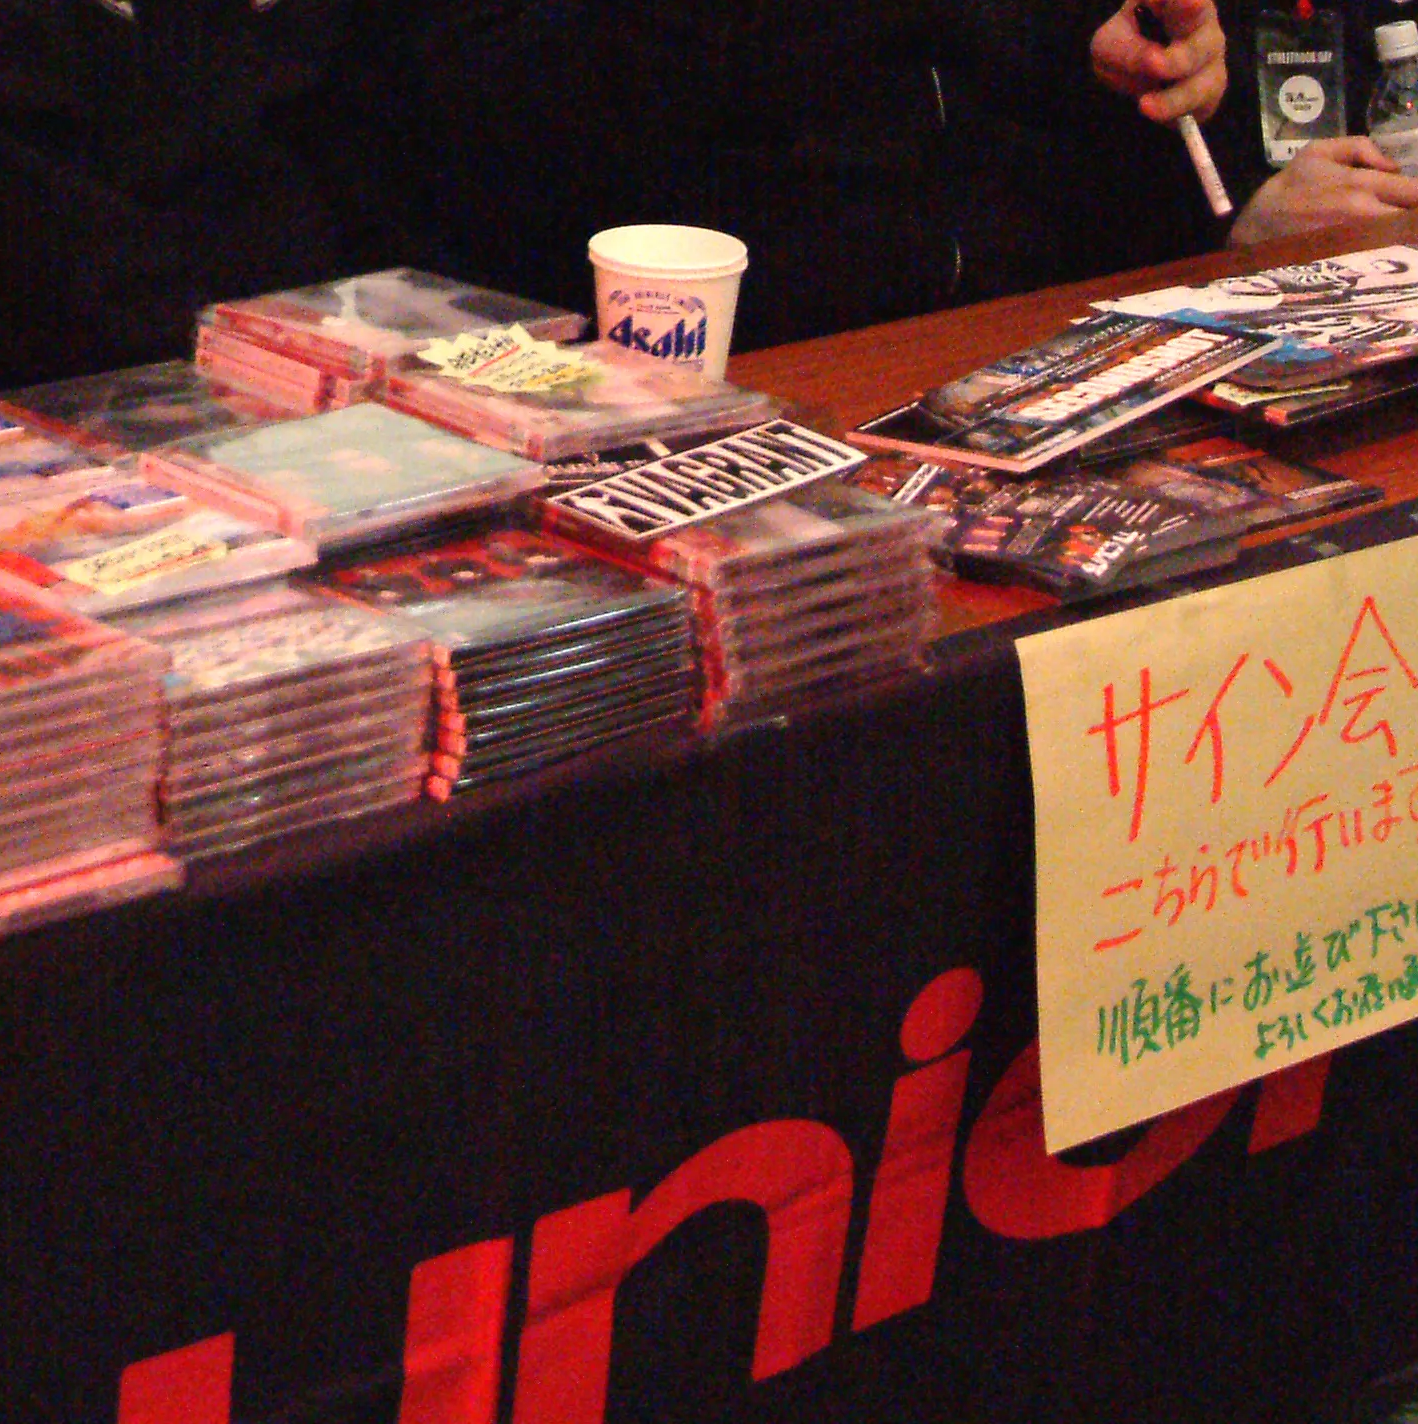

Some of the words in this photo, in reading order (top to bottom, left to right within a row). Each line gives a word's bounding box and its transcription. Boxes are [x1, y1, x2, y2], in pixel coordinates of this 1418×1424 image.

[608, 316, 707, 359] Asahi
[1087, 595, 1418, 843] サイン会
